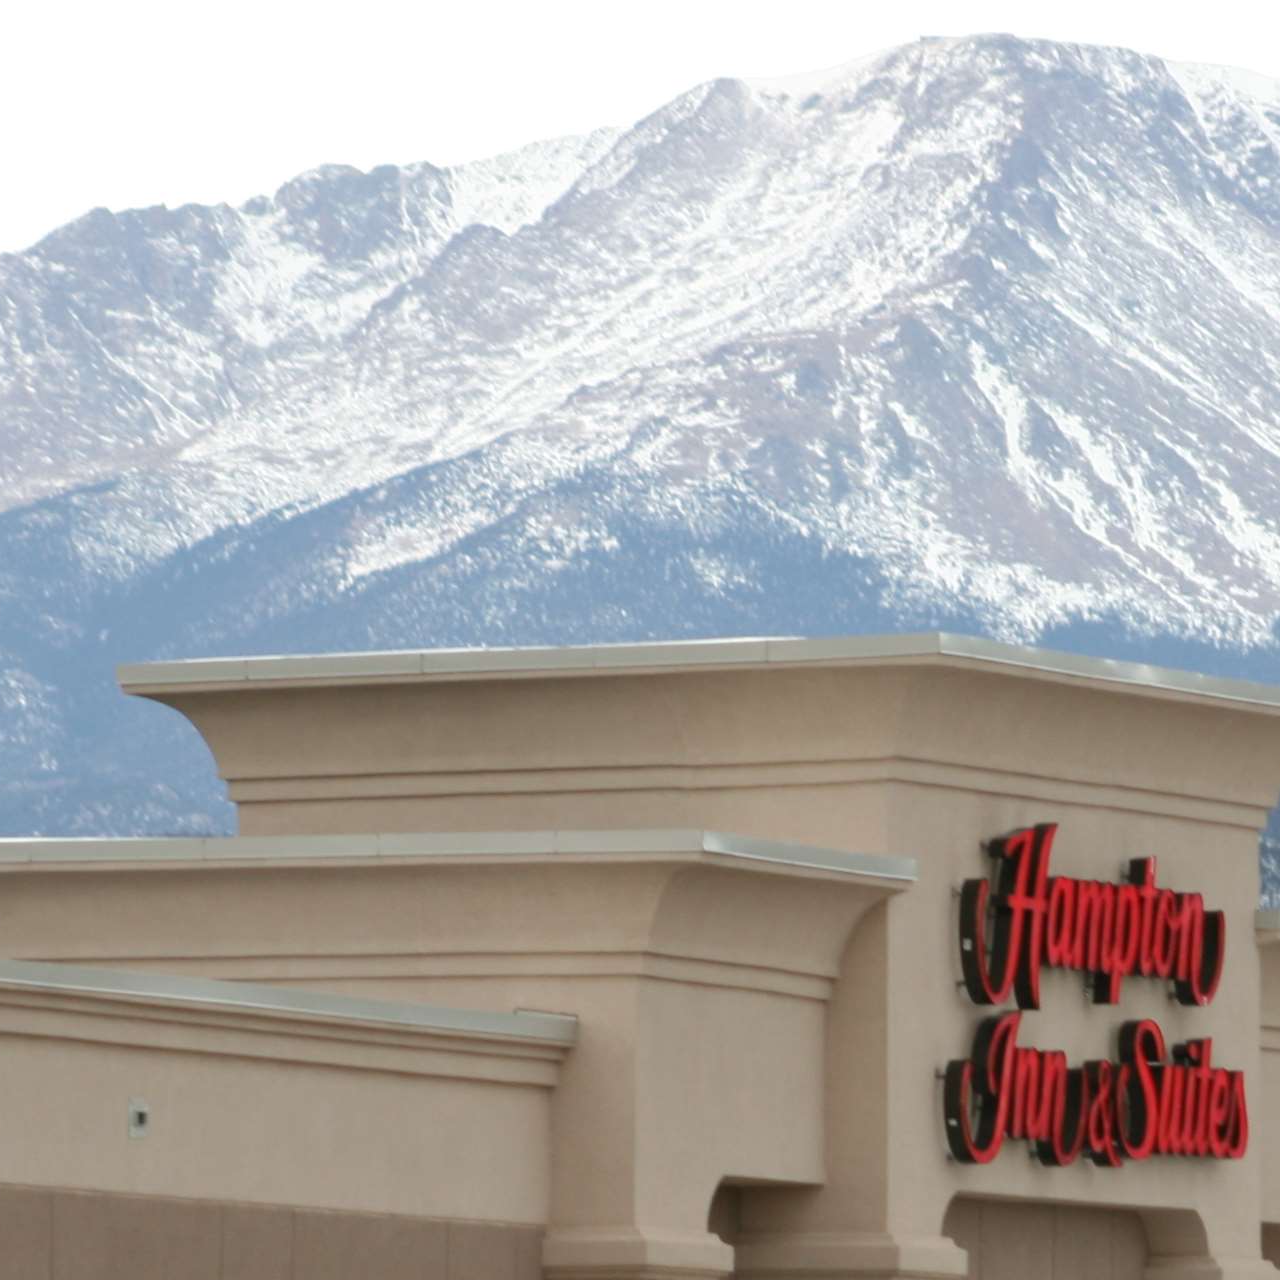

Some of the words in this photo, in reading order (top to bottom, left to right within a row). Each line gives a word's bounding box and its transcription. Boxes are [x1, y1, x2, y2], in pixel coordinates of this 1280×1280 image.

[959, 823, 1226, 1010] Hampton
[945, 1010, 1087, 1166] Inn
[1084, 1060, 1124, 1168] &
[1120, 1018, 1248, 1160] Suites
